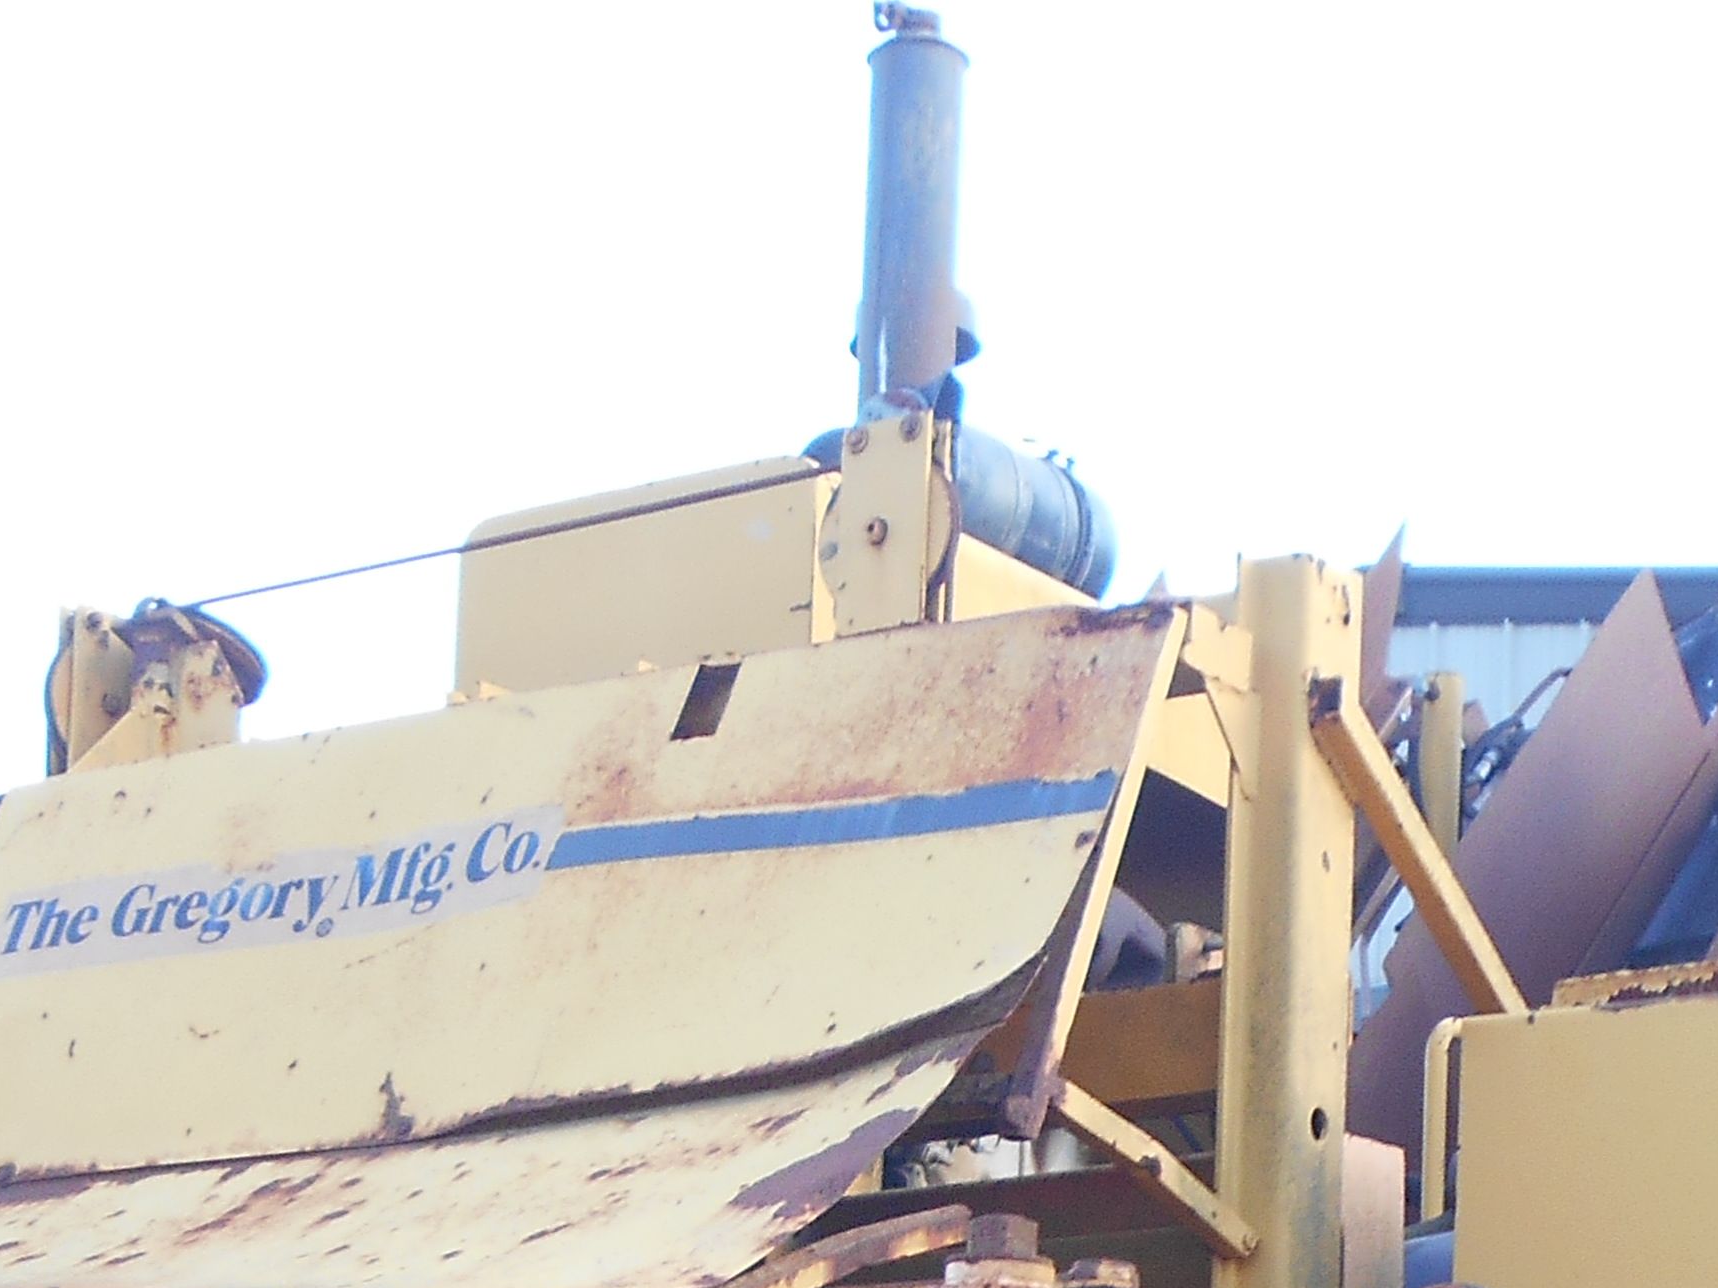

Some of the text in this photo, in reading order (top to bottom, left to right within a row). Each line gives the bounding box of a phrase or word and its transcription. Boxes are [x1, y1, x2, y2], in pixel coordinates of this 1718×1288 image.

[1, 821, 541, 956] The Gregory Mfg. Co.
